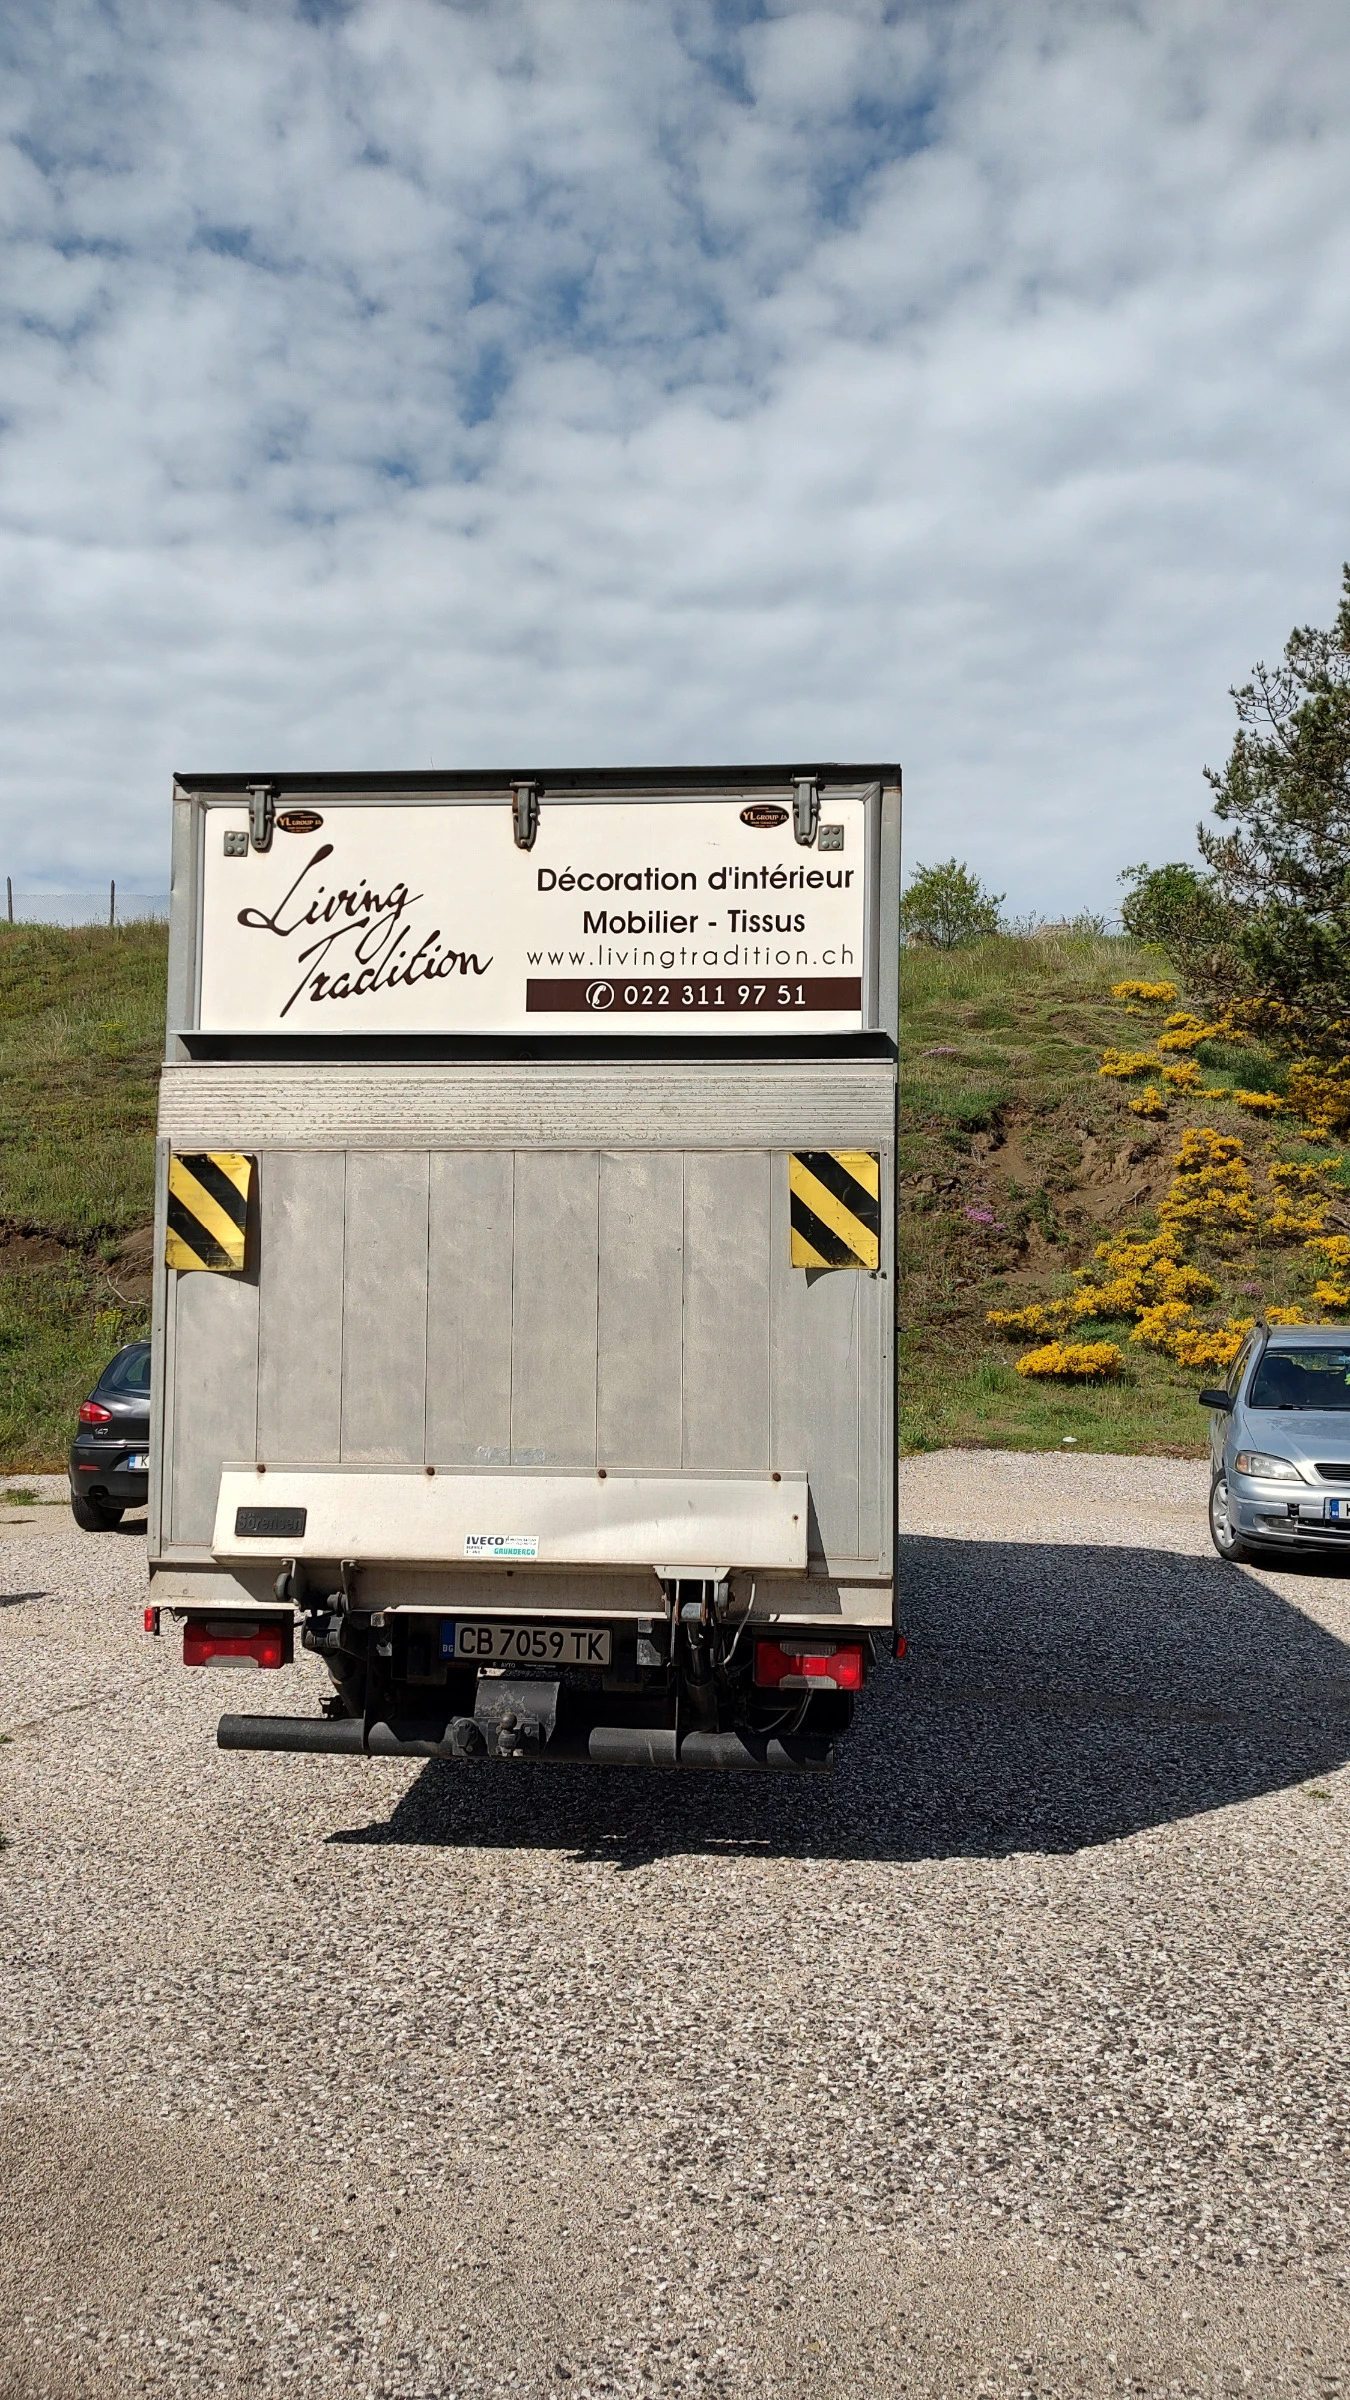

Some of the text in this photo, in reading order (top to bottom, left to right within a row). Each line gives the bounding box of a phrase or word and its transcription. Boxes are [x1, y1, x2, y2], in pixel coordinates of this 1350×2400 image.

[537, 864, 854, 892] Décoration d'intérieur
[237, 844, 424, 965] Living
[583, 910, 698, 934] Mobilier
[728, 910, 805, 932] Tissus
[279, 916, 493, 1018] Tradition
[527, 944, 854, 969] www.livingtradition.ch
[624, 985, 805, 1004] 022 311 97 51
[466, 1536, 504, 1545] IVECO
[442, 1644, 454, 1653] BG
[459, 1627, 604, 1661] CB 7059 TK
